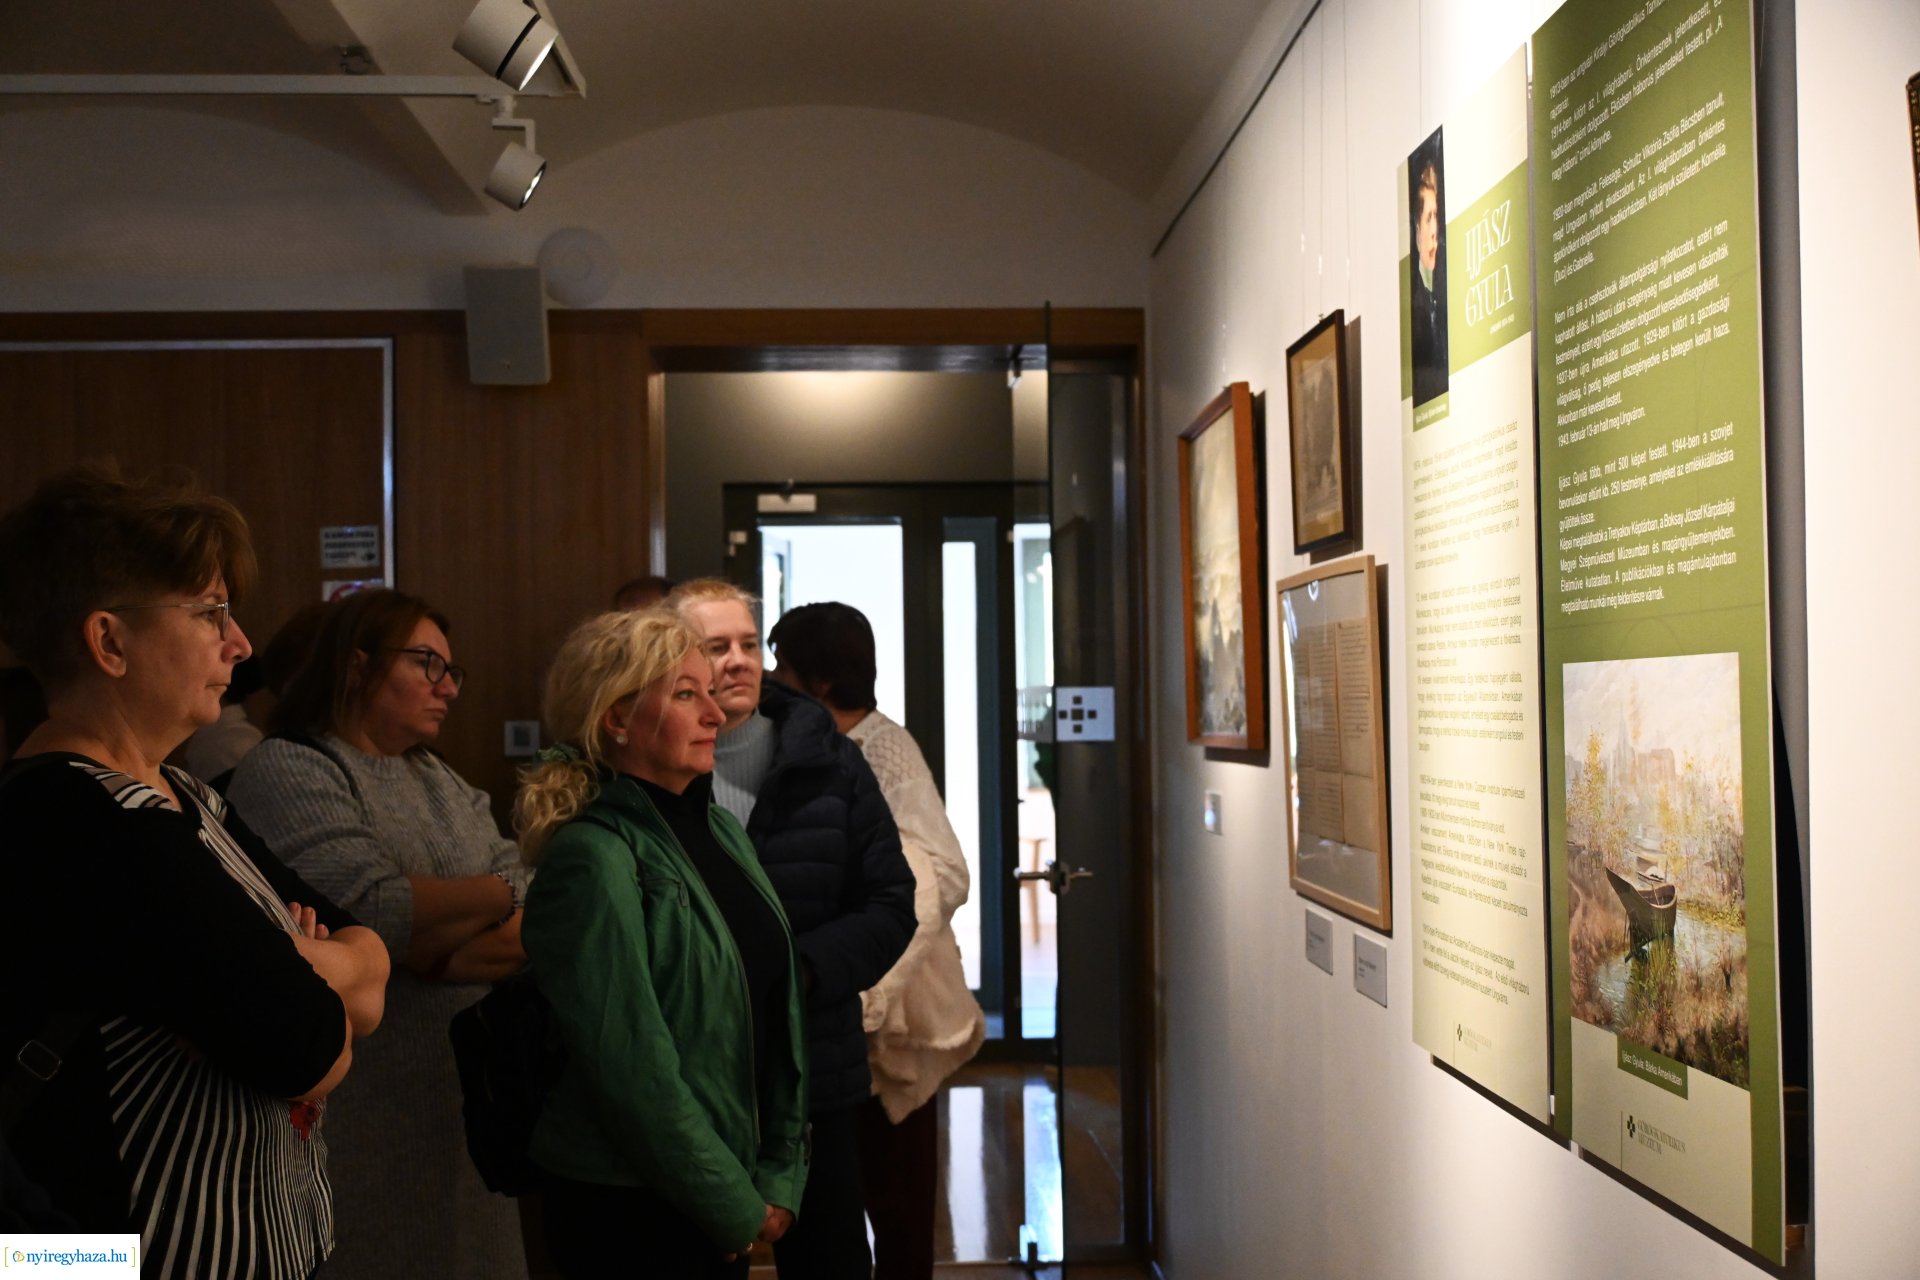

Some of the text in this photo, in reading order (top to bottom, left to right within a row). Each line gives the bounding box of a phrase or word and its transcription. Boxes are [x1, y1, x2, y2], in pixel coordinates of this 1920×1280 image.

[1550, 116, 1572, 140] 1914-ben
[1573, 103, 1586, 122] kitört
[1588, 98, 1595, 111] az
[1596, 91, 1601, 103] I.
[1662, 125, 1680, 147] Zsófia
[1680, 107, 1705, 134] Bécsben
[1705, 92, 1725, 116] tanult,
[1637, 173, 1646, 187] Az
[1647, 167, 1652, 180] I.
[1698, 118, 1726, 146] önkéntes
[1466, 200, 1510, 280] IJJÁSZ
[1554, 311, 1566, 324] Nem
[1584, 298, 1588, 309] a
[1696, 227, 1713, 247] ezért
[1713, 221, 1728, 236] nem
[1566, 263, 1573, 276] és
[1466, 264, 1514, 327] GYULA
[1590, 313, 1595, 327] A
[1595, 304, 1613, 324] háború
[1673, 262, 1697, 283] kevesen
[1556, 368, 1578, 385] 1927-ben
[1643, 325, 1670, 345] 1929-ben
[1672, 314, 1688, 332] kitört
[1690, 313, 1695, 325] a
[1697, 293, 1730, 325] gazdasági
[1581, 337, 1594, 353] ezért
[1587, 377, 1602, 396] pedig
[1661, 348, 1670, 362] és
[1670, 338, 1694, 358] betegen
[1713, 322, 1730, 339] haza.
[1605, 391, 1622, 408] festett.
[1618, 455, 1629, 471] 500
[1630, 450, 1647, 468] képet
[1648, 444, 1669, 461] festett.
[1671, 435, 1700, 453] 1944-ben
[1702, 432, 1708, 444] a
[1710, 422, 1733, 442] szovjet
[1601, 484, 1610, 497] kb.
[1610, 480, 1621, 495] 250
[1676, 464, 1685, 477] az
[1604, 531, 1608, 542] a
[1659, 518, 1664, 529] a
[1663, 513, 1684, 528] Boksay
[1683, 505, 1703, 523] József
[1651, 540, 1660, 554] és
[1614, 570, 1620, 583] A
[1666, 560, 1675, 575] és
